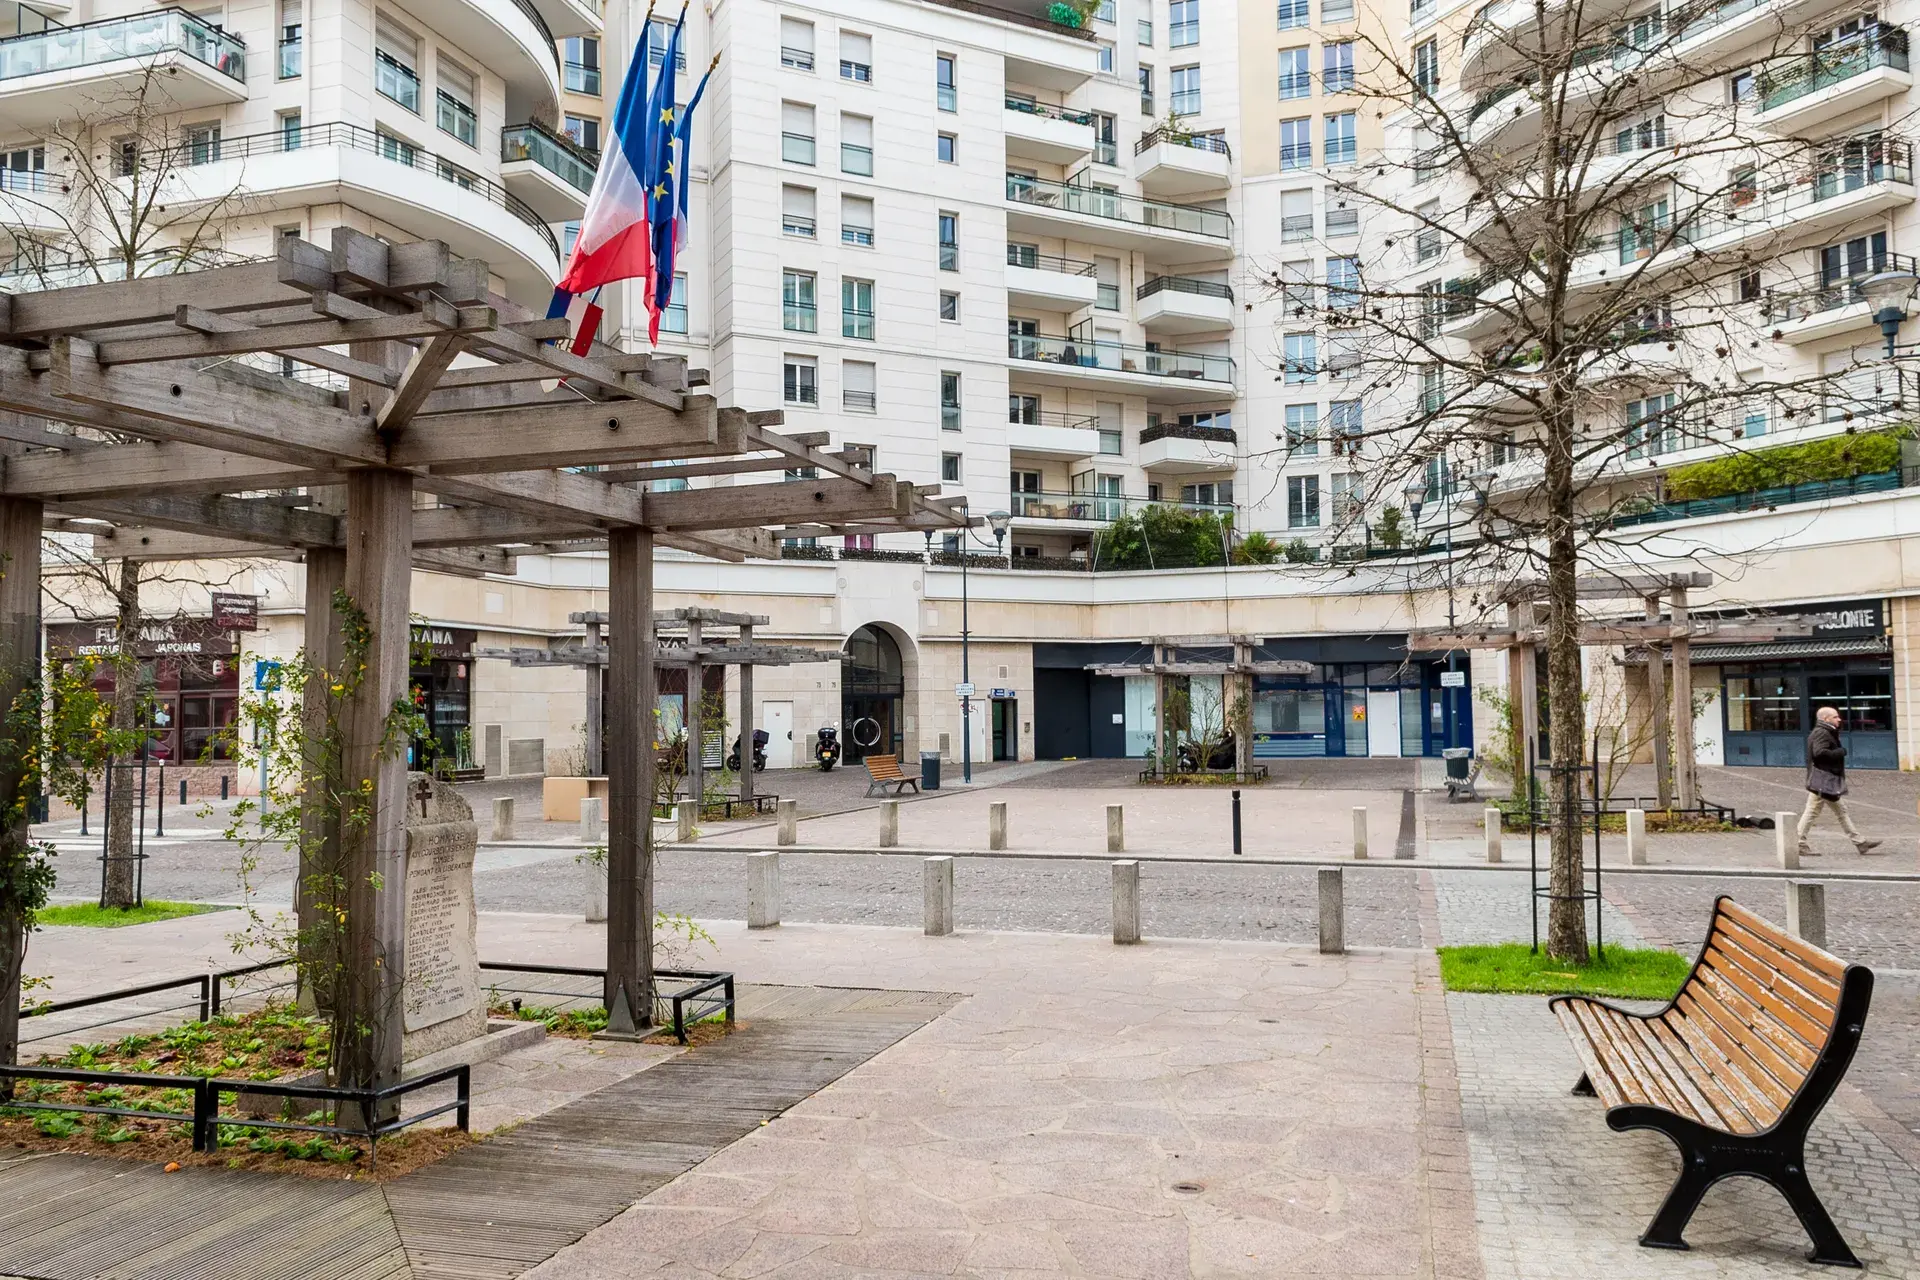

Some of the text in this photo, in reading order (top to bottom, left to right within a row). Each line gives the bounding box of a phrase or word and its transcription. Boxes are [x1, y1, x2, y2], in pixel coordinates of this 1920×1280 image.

[1817, 609, 1875, 630] LONTE
[95, 626, 177, 643] FUAMA
[411, 628, 454, 645] YAMA
[154, 641, 202, 653] JAPONAIS
[428, 832, 465, 846] HOMMAGE
